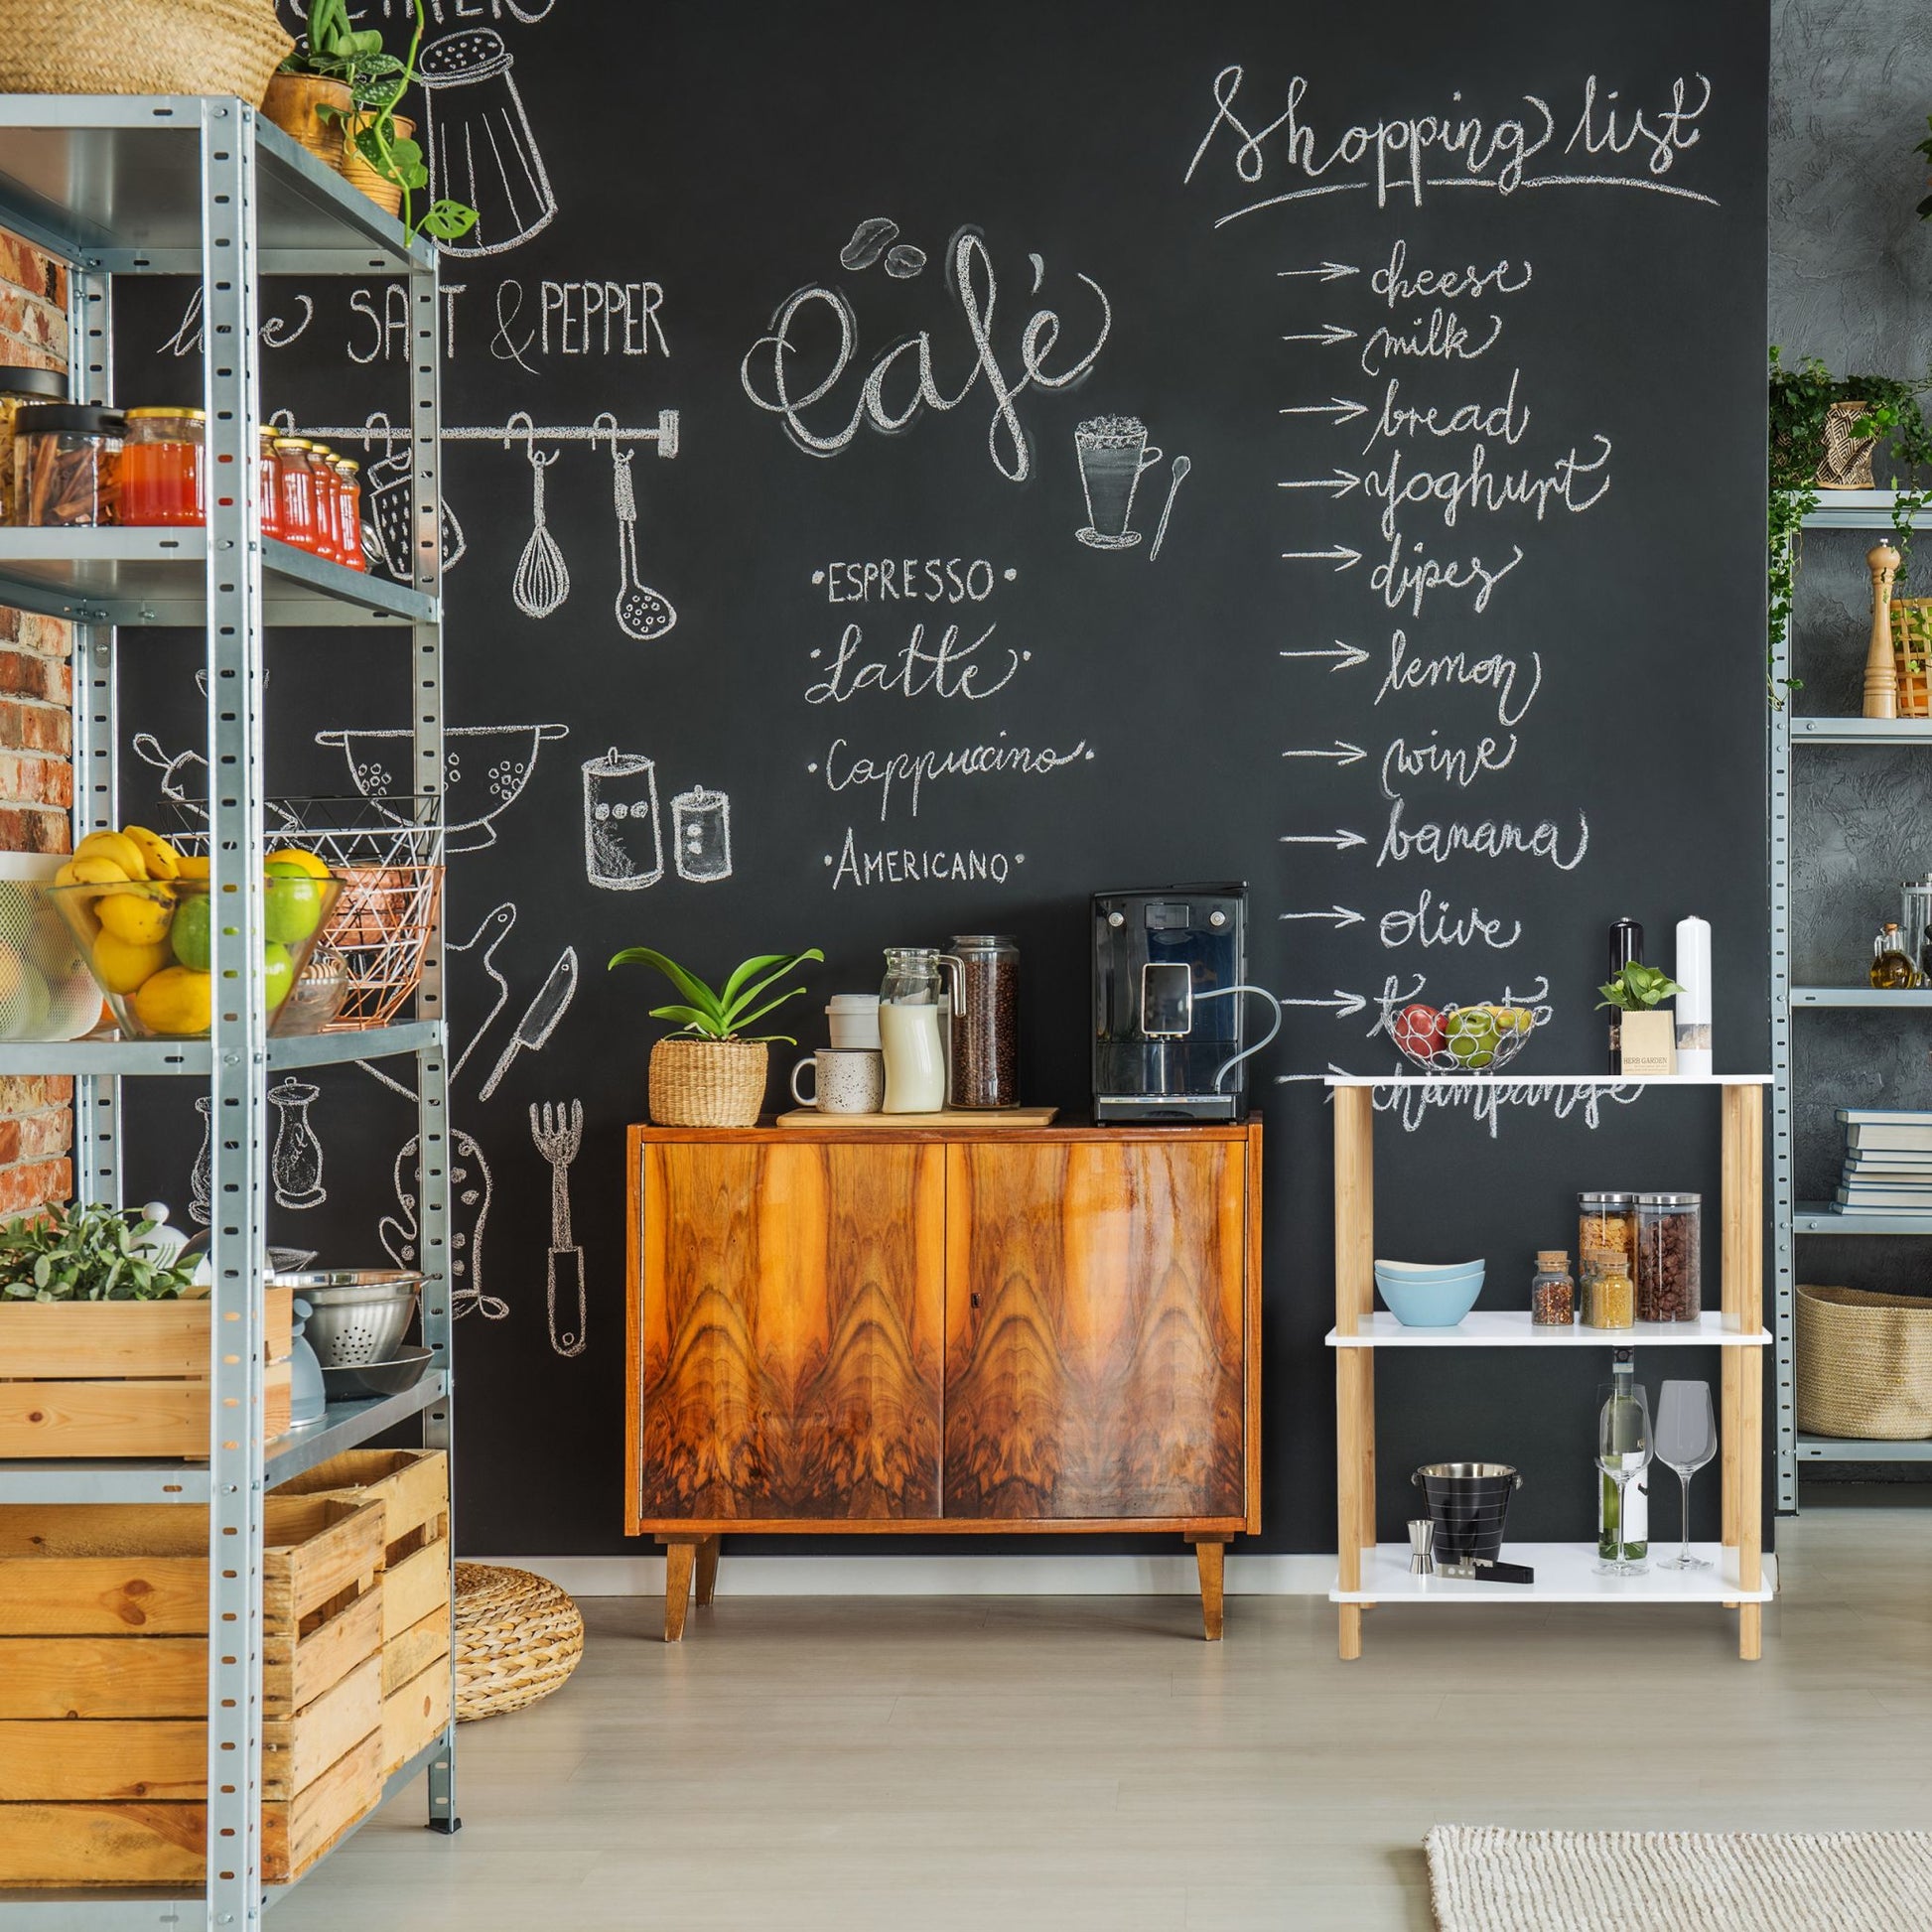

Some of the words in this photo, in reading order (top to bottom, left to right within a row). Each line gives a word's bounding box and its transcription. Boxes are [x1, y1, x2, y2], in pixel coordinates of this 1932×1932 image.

[1183, 65, 1554, 208] Shopping
[1564, 72, 1711, 175] list
[1371, 239, 1532, 308] cheese
[347, 282, 468, 364] SAT
[490, 279, 541, 375] &
[541, 280, 671, 357] PEPPER
[1362, 308, 1502, 376] milk
[1362, 368, 1530, 456] bread
[827, 558, 994, 603] ESPRESSO
[804, 623, 1019, 704] Latte
[1374, 629, 1542, 726] lemon
[826, 731, 1086, 821] Cappuccino
[1381, 730, 1517, 797] wine
[1376, 796, 1588, 870] banana
[1379, 890, 1522, 948] olive
